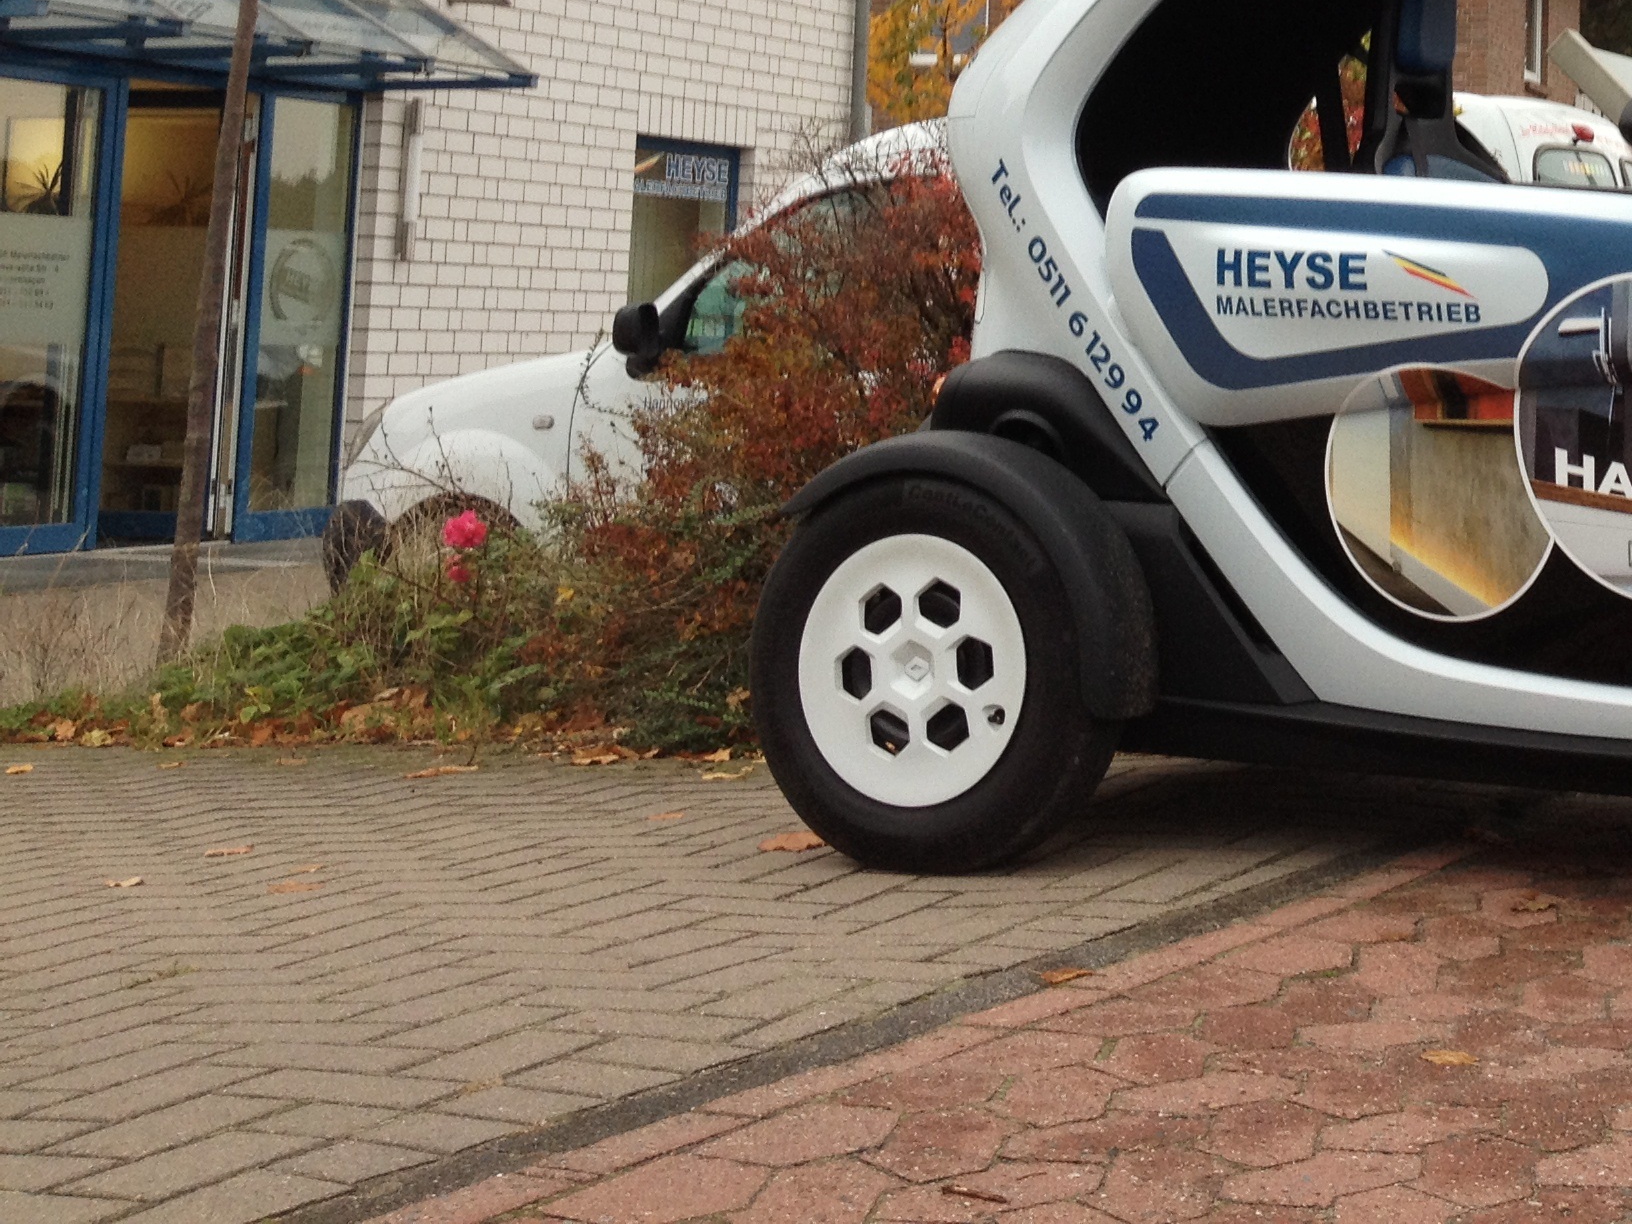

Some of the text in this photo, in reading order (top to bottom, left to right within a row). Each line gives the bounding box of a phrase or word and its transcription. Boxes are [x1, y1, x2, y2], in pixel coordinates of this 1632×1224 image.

[665, 152, 730, 185] HEYSE
[991, 158, 1027, 233] Tel.:
[1028, 235, 1072, 309] 0511
[1216, 247, 1368, 292] HEYSE
[1216, 294, 1482, 324] MALERFACHBETRIEB
